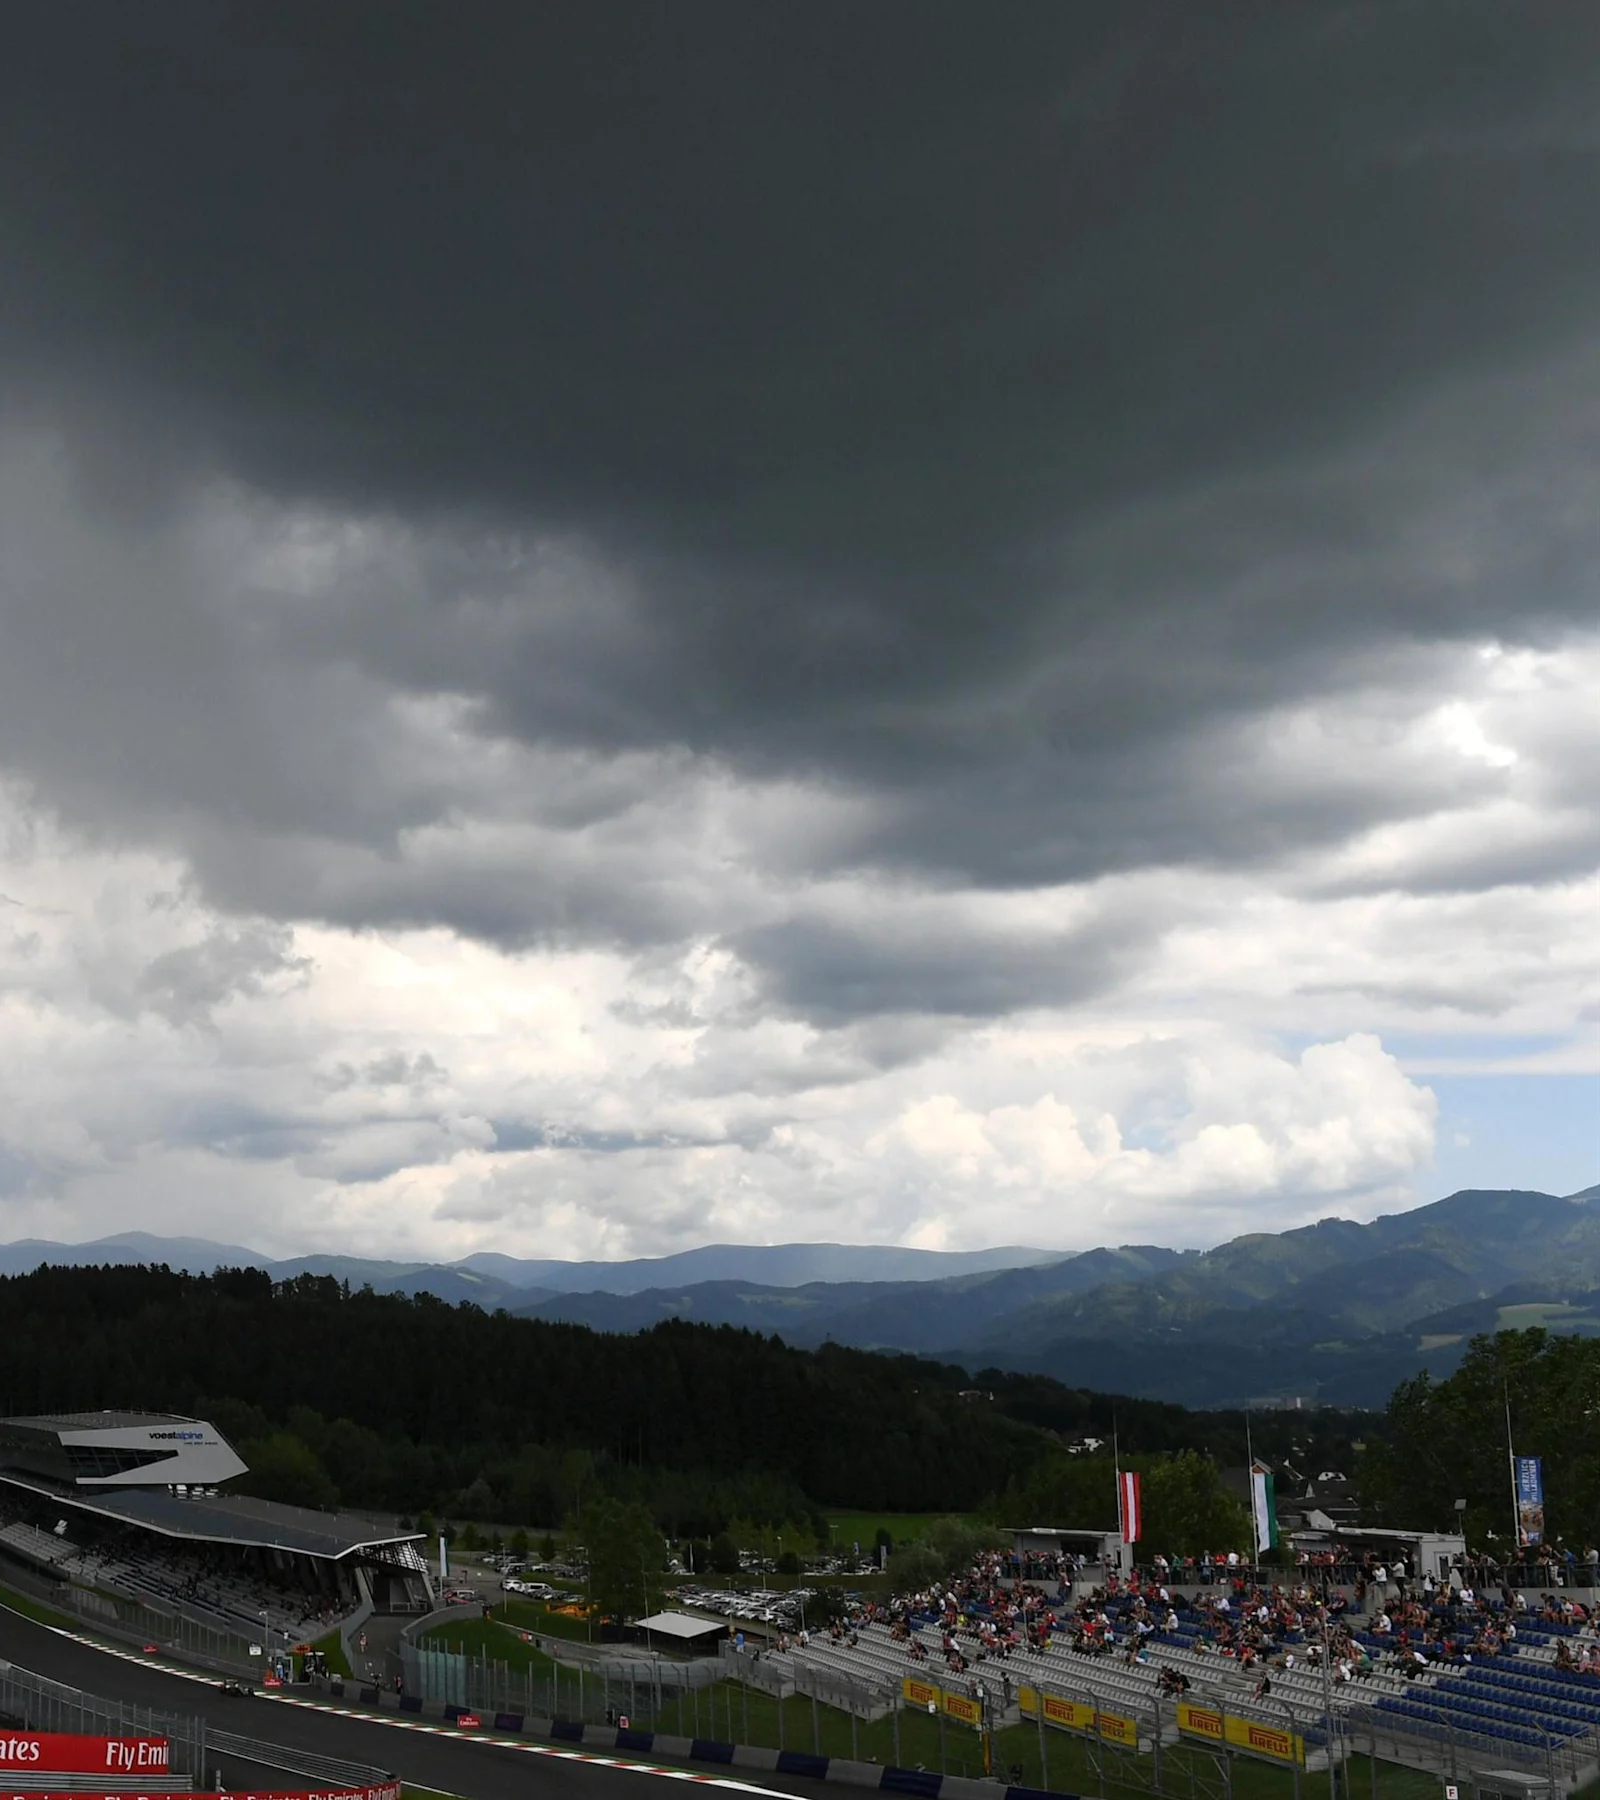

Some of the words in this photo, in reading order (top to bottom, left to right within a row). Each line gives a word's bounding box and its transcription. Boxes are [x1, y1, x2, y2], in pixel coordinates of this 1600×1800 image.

[148, 1430, 204, 1441] voestalpine
[1045, 1698, 1074, 1722] PIRELLI
[1248, 1725, 1289, 1755] PIRELLI
[106, 1741, 137, 1771] Fly
